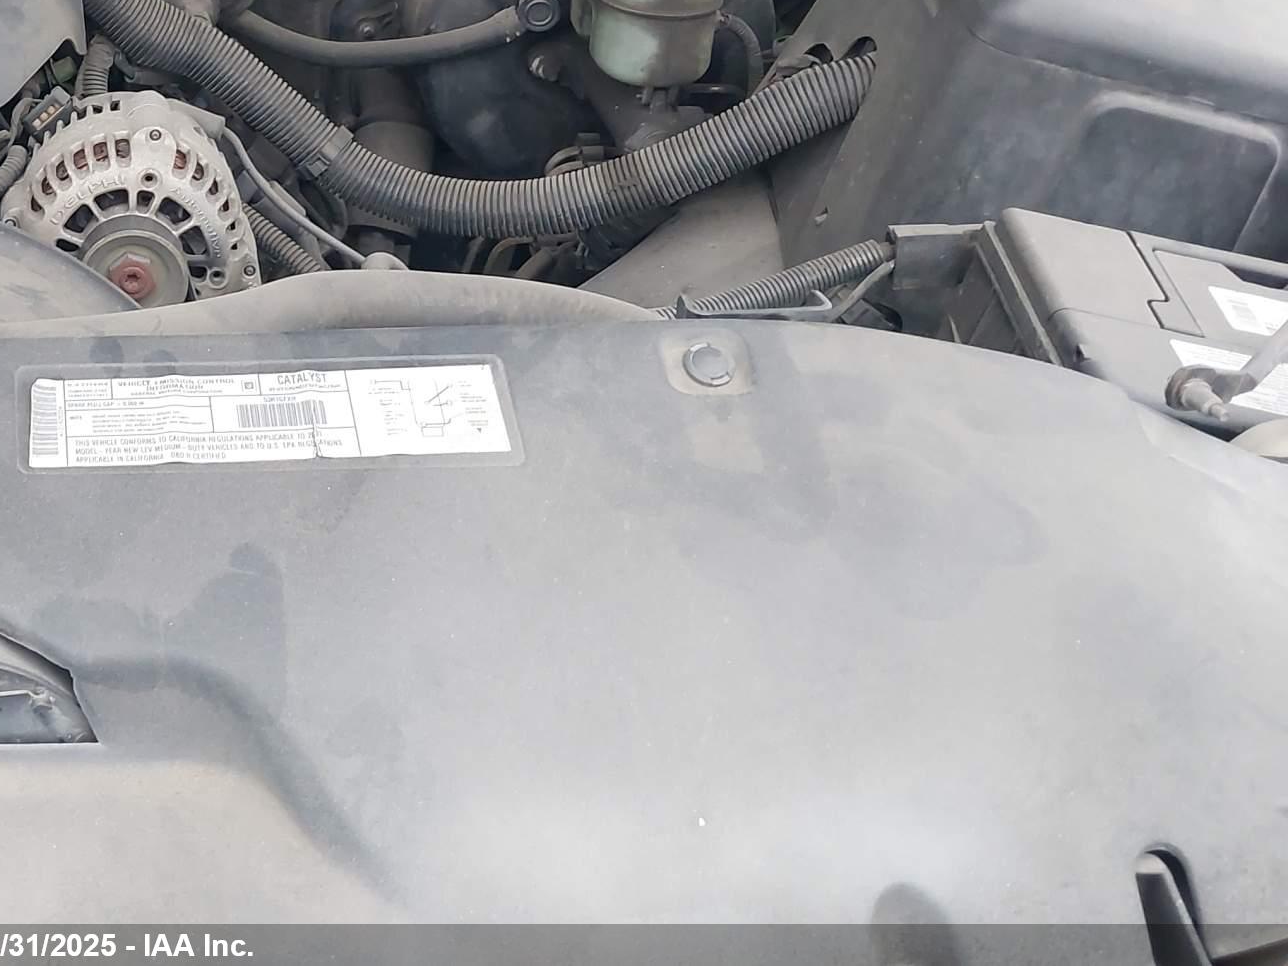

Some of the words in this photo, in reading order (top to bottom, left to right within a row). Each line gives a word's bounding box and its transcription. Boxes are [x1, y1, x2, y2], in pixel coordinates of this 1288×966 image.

[277, 372, 327, 385] CATALYST
[92, 438, 117, 446] VEHICLE
[120, 437, 156, 445] CONFORMS
[168, 434, 207, 443] CALIFORNIA
[209, 434, 253, 442] REGULATIONS
[255, 433, 294, 441] APPLICABLE
[75, 447, 98, 455] MODEL
[123, 446, 139, 454] NEW
[154, 444, 181, 452] MEDIUM
[207, 442, 238, 450] VEHICLES
[297, 439, 343, 447] REGUATIONS
[75, 455, 113, 463] APPLICABLE
[125, 453, 164, 462] CALIFORNIA
